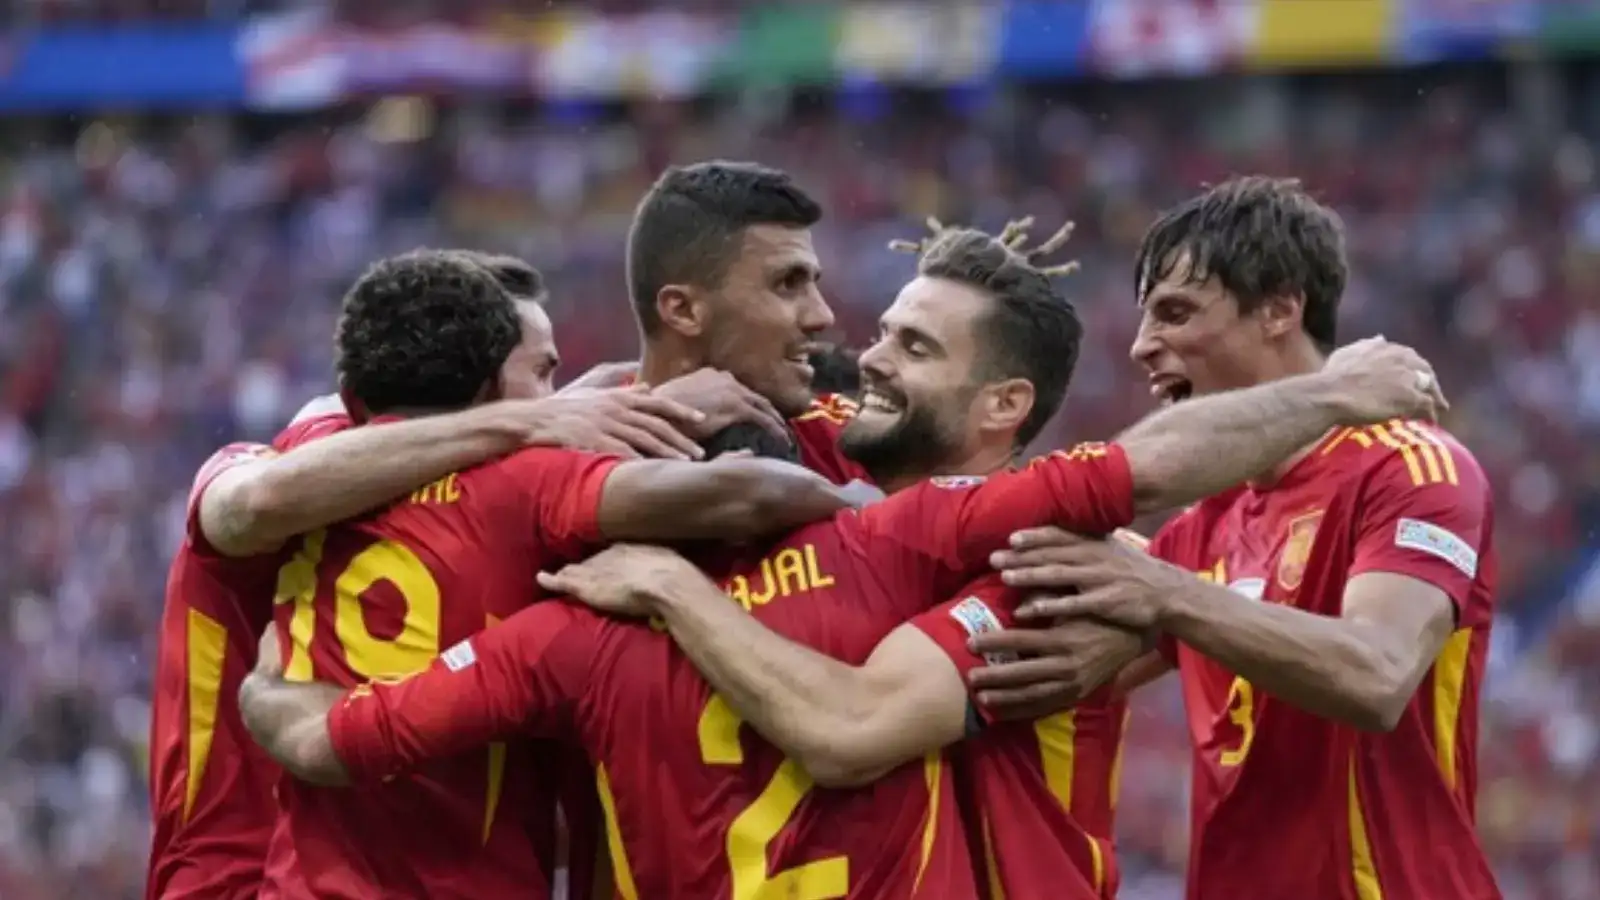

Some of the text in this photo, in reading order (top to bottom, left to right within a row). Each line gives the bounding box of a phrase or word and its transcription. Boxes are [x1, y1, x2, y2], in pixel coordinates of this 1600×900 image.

[726, 543, 835, 612] AJAL
[1219, 674, 1254, 766] 3
[698, 692, 848, 900] 2
